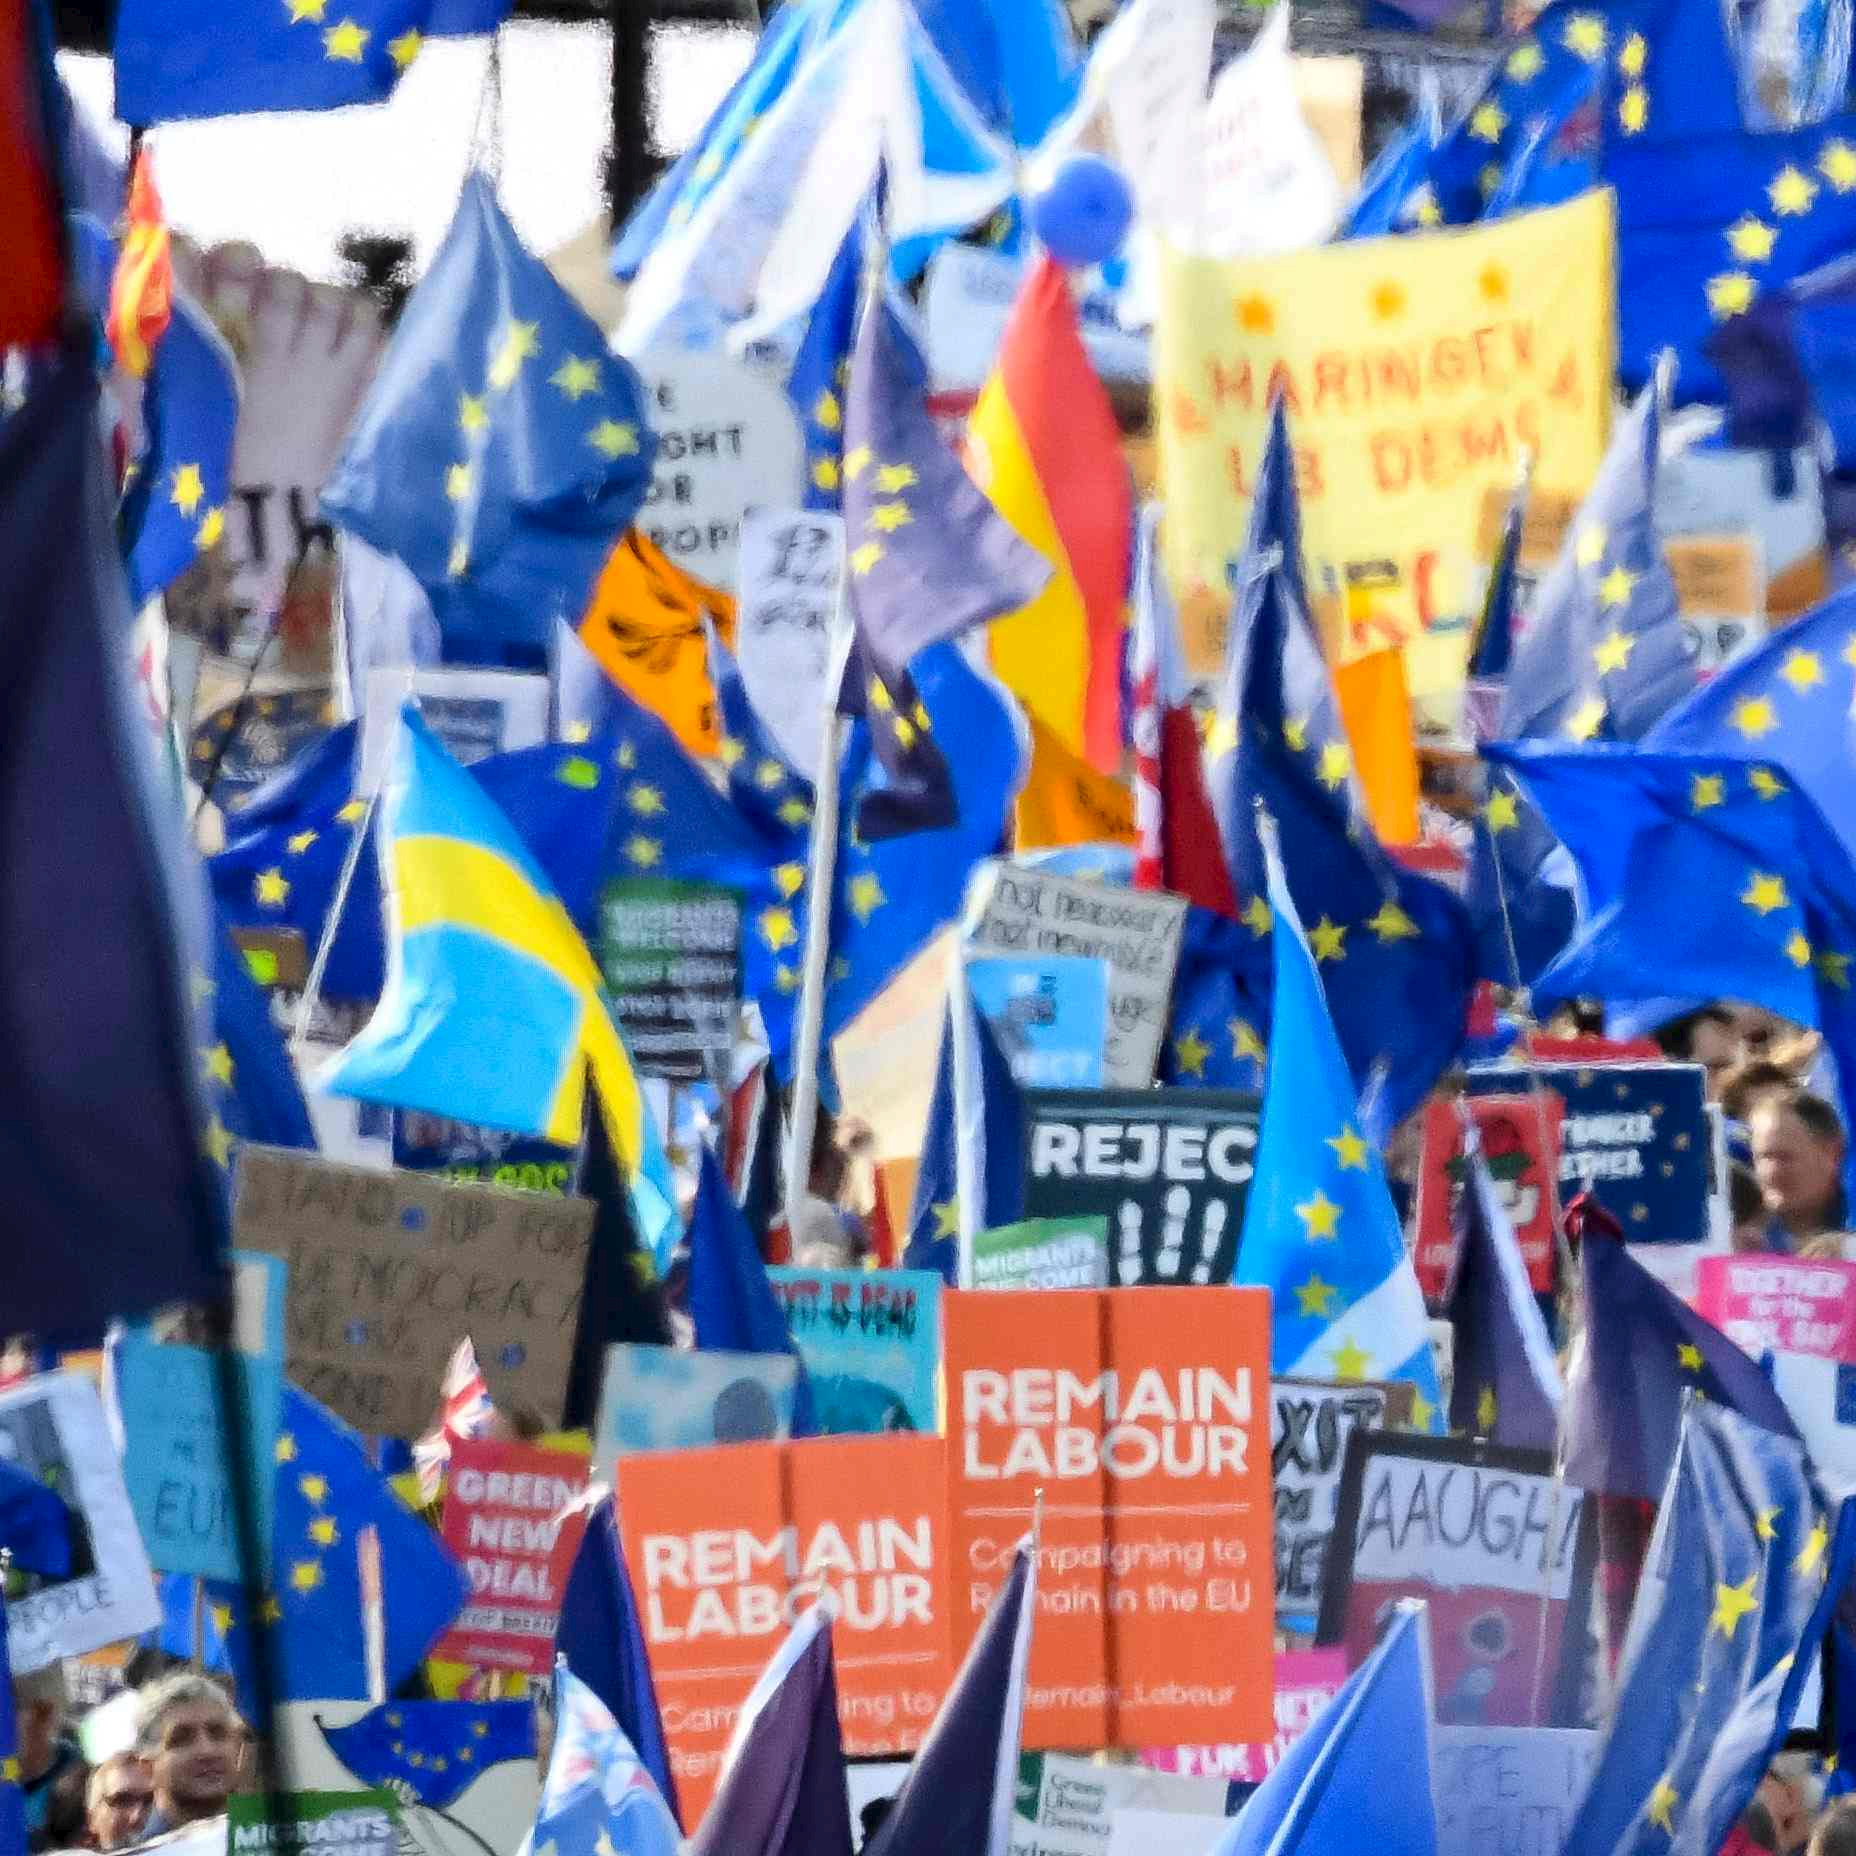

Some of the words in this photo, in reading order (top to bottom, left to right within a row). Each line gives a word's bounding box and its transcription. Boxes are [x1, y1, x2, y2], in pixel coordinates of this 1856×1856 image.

[1230, 446, 1328, 500] LB
[961, 1367, 1252, 1425] REMAIN
[961, 1427, 1250, 1482] LABOUR
[456, 1466, 580, 1509] GREEN
[470, 1514, 564, 1554] NEW
[643, 1516, 935, 1588] REMAIN
[467, 1557, 558, 1602] DEAL
[967, 1582, 1098, 1614] Rmain
[1145, 1582, 1197, 1613] the
[1203, 1580, 1252, 1614] EU
[647, 1572, 937, 1643] LABOUR
[1024, 1679, 1237, 1712] emain_Labour
